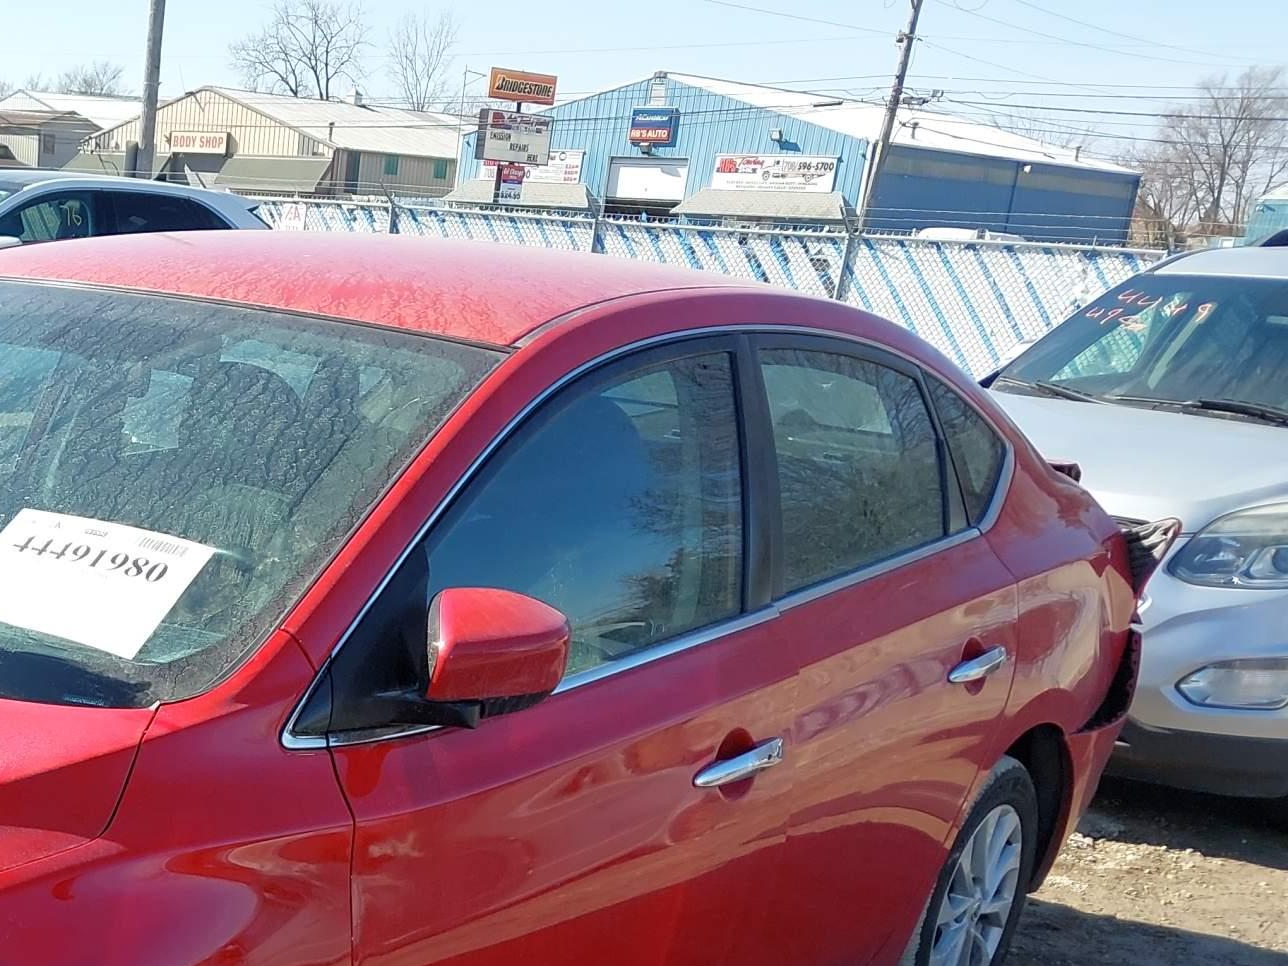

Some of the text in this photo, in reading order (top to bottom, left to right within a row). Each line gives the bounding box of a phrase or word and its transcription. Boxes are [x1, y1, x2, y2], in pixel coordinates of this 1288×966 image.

[495, 75, 553, 98] BRIDGESTONE
[173, 135, 224, 149] BODY SHOP
[647, 129, 668, 138] AUTO
[12, 535, 169, 583] 44491980
